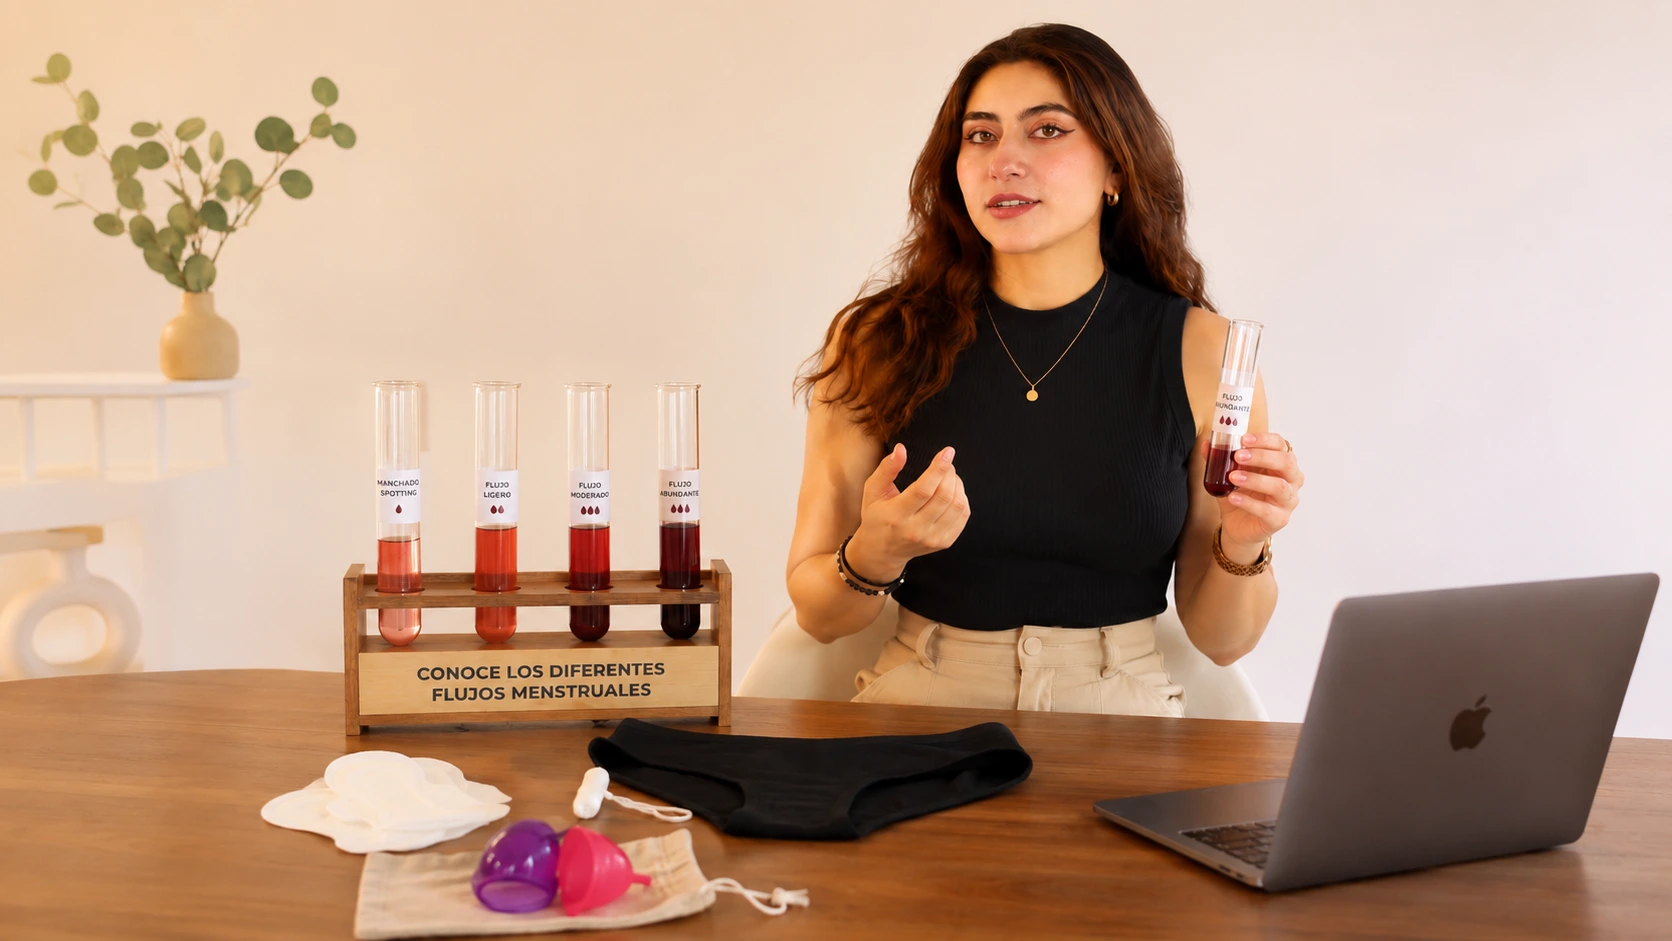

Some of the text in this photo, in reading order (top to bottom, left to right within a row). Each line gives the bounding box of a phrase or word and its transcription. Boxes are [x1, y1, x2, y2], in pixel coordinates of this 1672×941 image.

[377, 478, 420, 487] MANCHADO
[668, 480, 692, 488] FLUJO
[380, 489, 417, 497] SPOTTING
[483, 491, 512, 499] LIGERO
[570, 491, 610, 499] MODERADO
[659, 489, 699, 498] ABUNDANTE
[417, 662, 665, 681] CONOCE LOS DIFERENTES
[432, 682, 651, 702] FLUJOS MENSTRUALES
